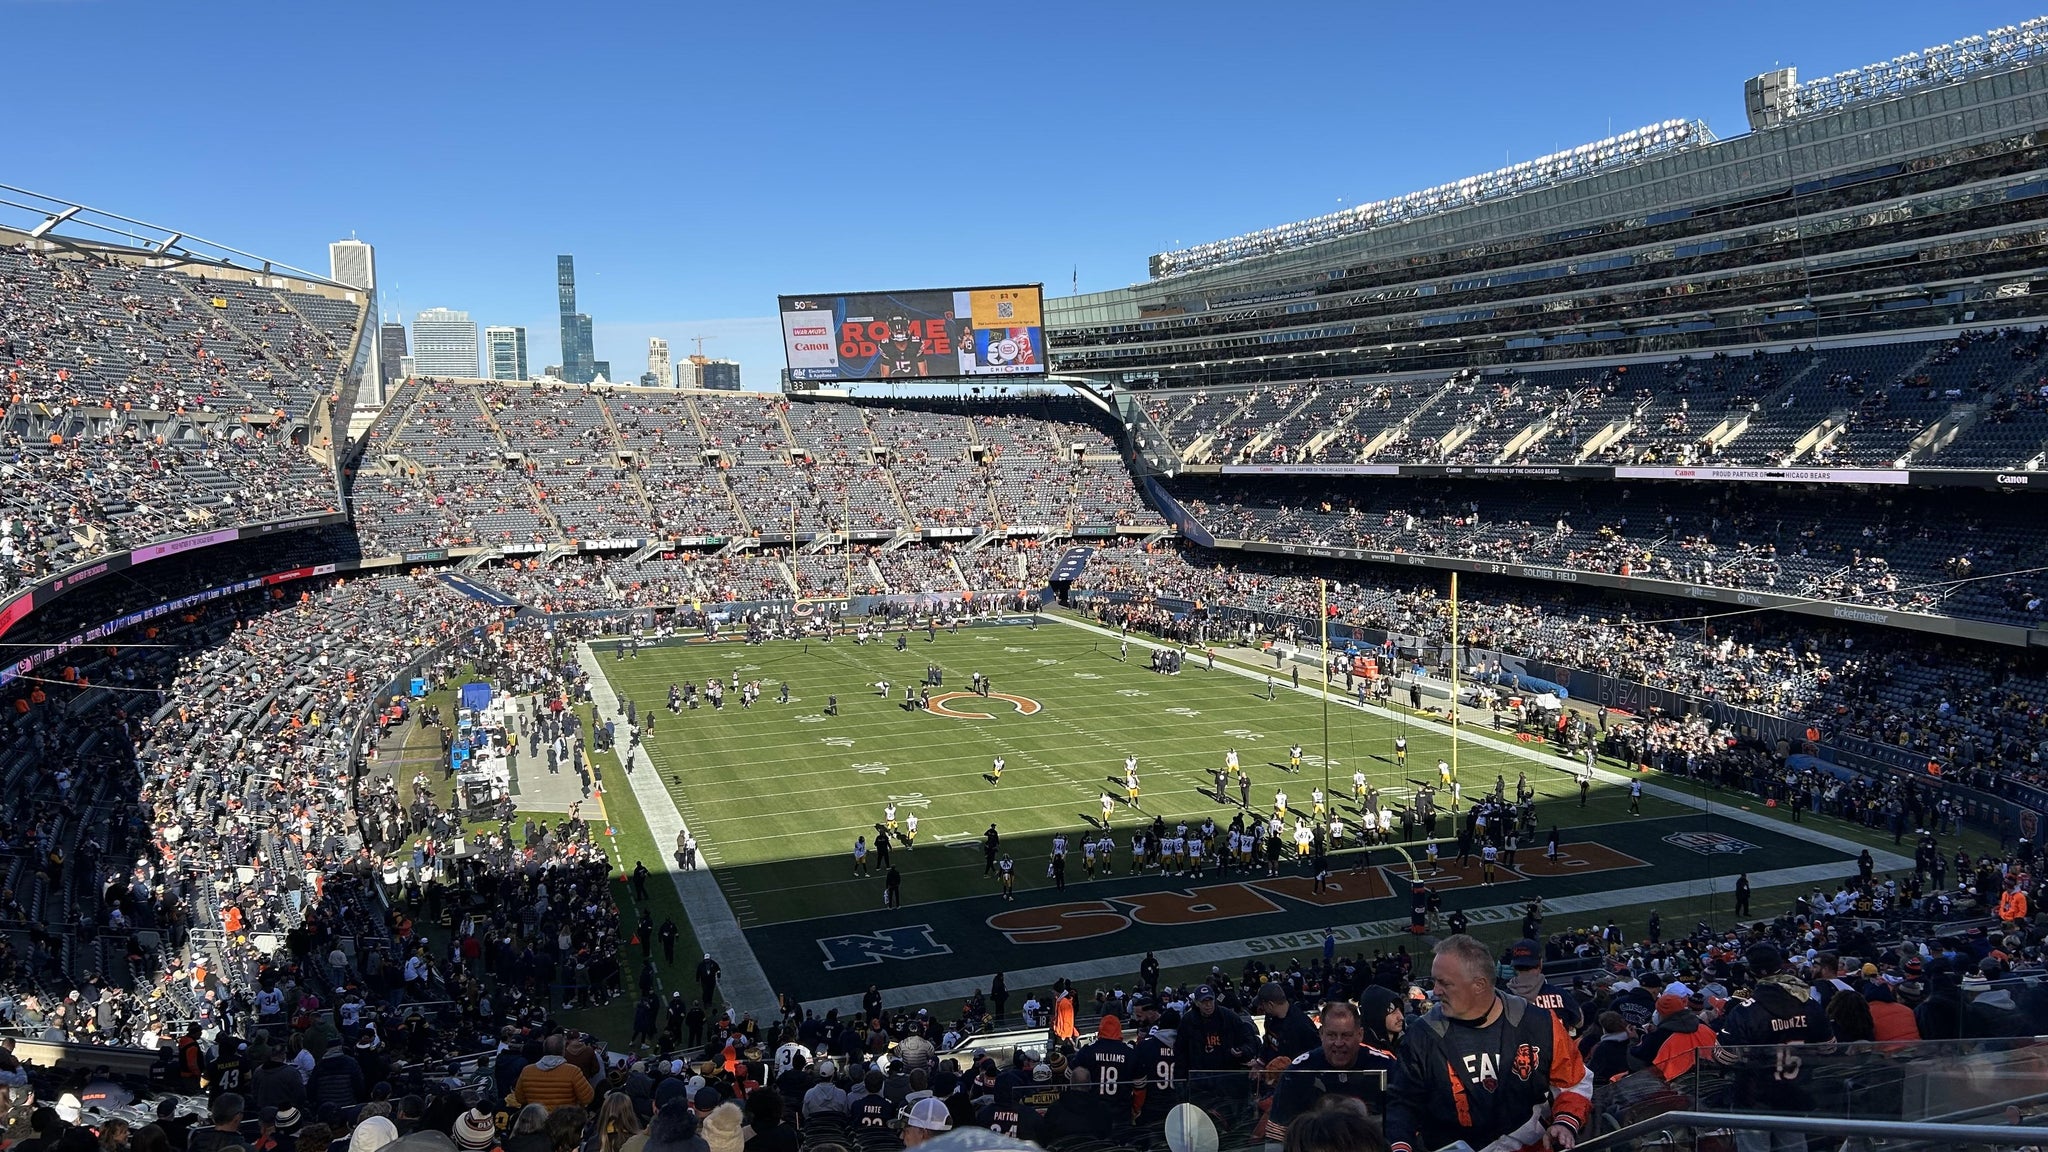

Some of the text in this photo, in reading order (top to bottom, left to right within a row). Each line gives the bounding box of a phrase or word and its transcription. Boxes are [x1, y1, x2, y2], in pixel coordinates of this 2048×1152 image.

[794, 343, 829, 351] Canon
[840, 339, 951, 358] ODZE
[793, 369, 806, 377] Abt
[1997, 474, 2028, 483] Canon
[931, 528, 972, 536] BEAR
[1007, 527, 1049, 535] DOWN
[585, 538, 638, 549] DOWN
[706, 535, 725, 544] BET
[502, 544, 547, 553] BEAR
[1524, 568, 1576, 581] SOLDIER FIELD
[1746, 595, 1762, 604] PNC
[1834, 607, 1888, 623] ticketmaster
[254, 916, 264, 925] 23
[264, 995, 277, 1005] 34
[1534, 994, 1564, 1009] CHER
[1039, 1016, 1046, 1026] 18
[1771, 1016, 1807, 1031] ODUNZE
[1095, 1053, 1125, 1063] WILLIAMS
[219, 1070, 239, 1090] 43
[1100, 1066, 1118, 1096] 18
[864, 1105, 881, 1114] FORTE
[994, 1112, 1018, 1121] PAYTON
